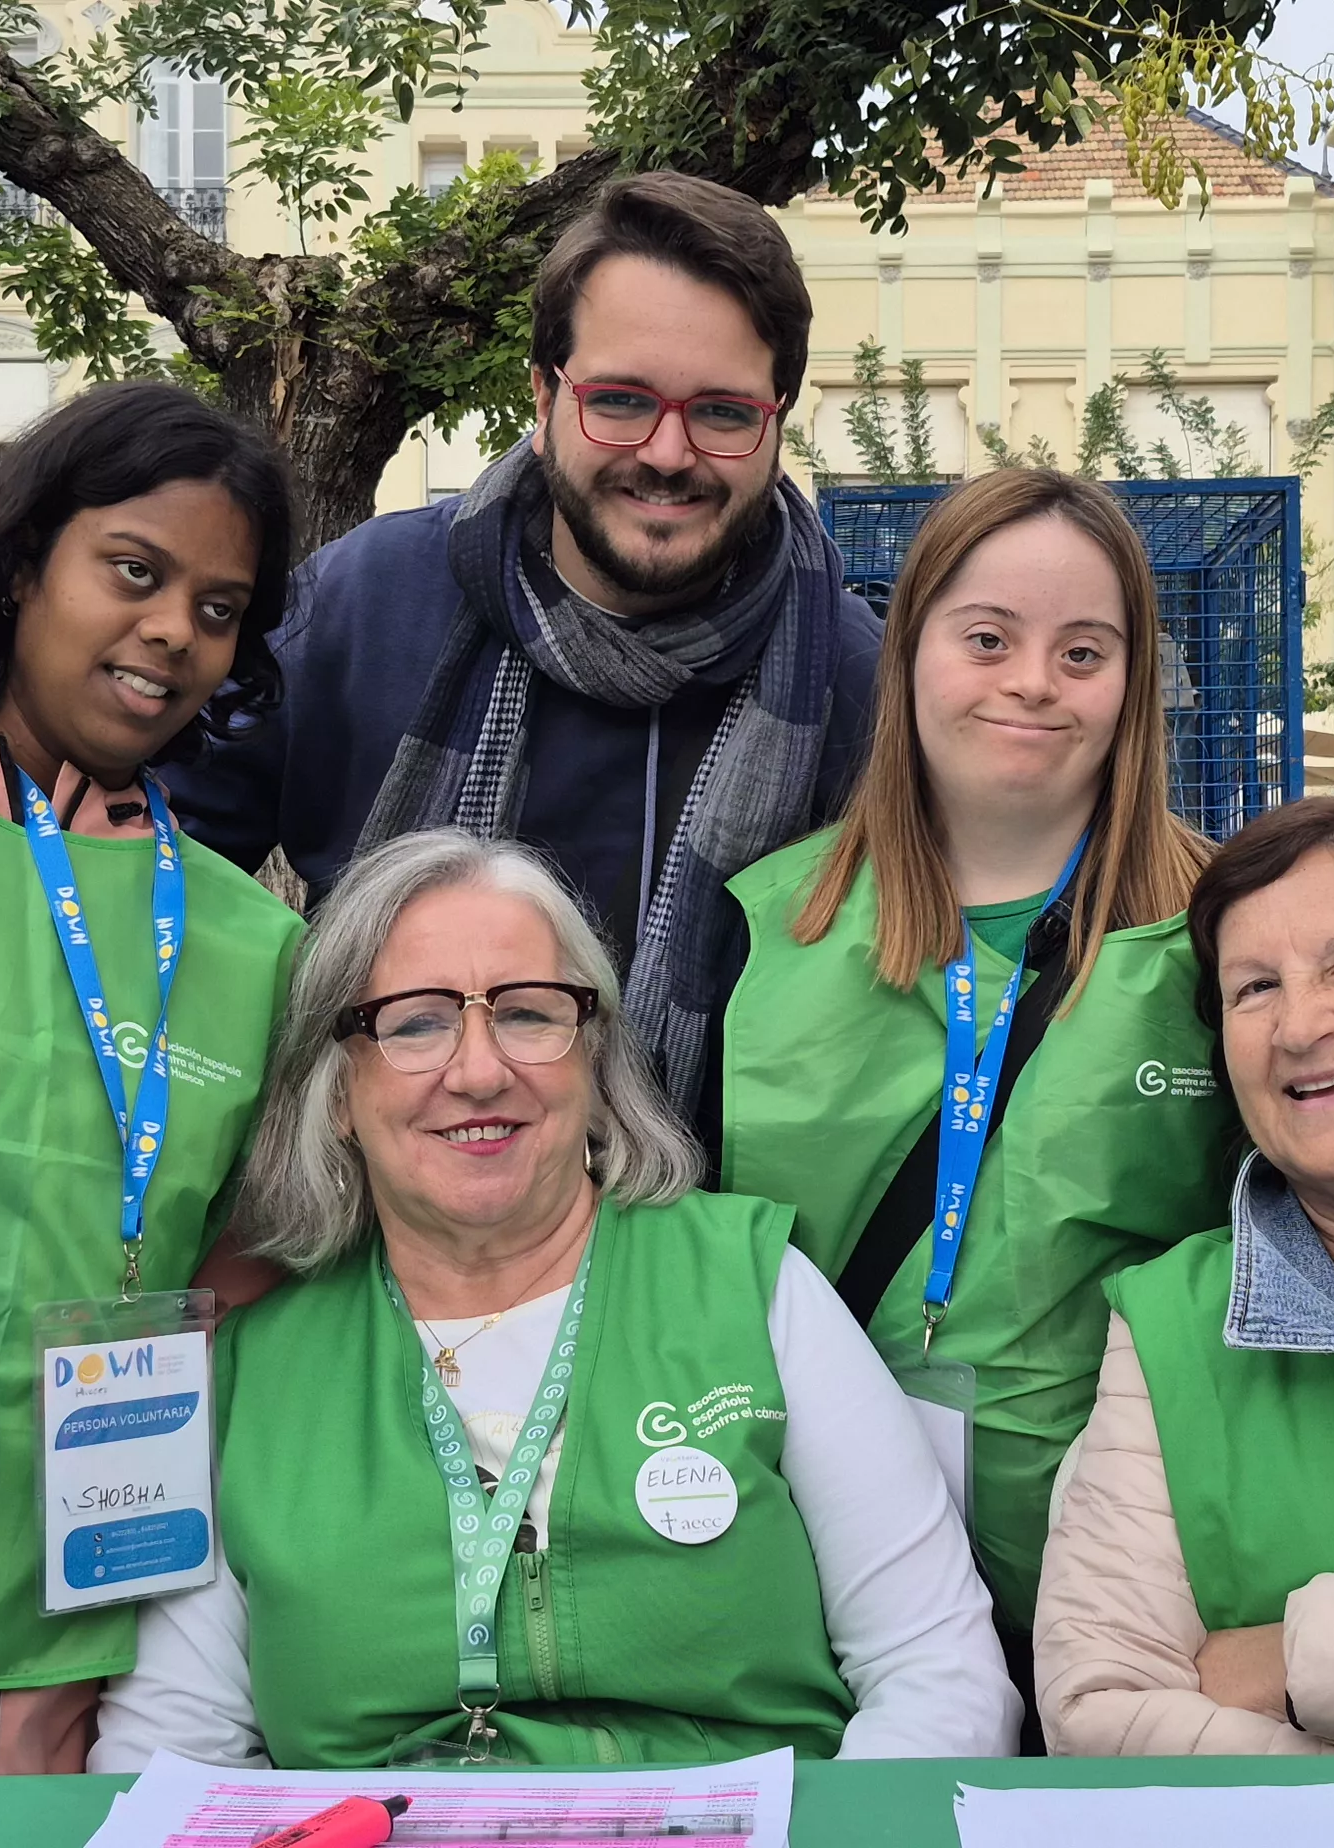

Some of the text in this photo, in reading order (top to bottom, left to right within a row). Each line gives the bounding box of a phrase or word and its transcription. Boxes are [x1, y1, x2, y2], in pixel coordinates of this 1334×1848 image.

[27, 788, 58, 837] DOWN
[156, 819, 175, 871] DOWN
[56, 886, 88, 944] DOWN
[155, 917, 175, 973] DOWN
[956, 965, 972, 1022] DOWN
[88, 998, 116, 1057] DOWN
[170, 1066, 204, 1086] Huesca
[202, 1056, 242, 1078] española
[1171, 1077, 1198, 1087] contra
[1199, 1078, 1207, 1087] el
[951, 1073, 971, 1131] DOWN
[965, 1076, 991, 1133] DOWN
[1170, 1087, 1183, 1095] en
[131, 1120, 161, 1178] DOWN
[941, 1183, 966, 1241] DOWN
[55, 1344, 153, 1387] DOWN
[64, 1405, 192, 1434] PERSONA VOLUNTARIA
[687, 1383, 754, 1414] asociación
[692, 1395, 751, 1426] española
[697, 1407, 788, 1439] contra el cáncer
[77, 1482, 166, 1511] SHOBHA
[647, 1465, 722, 1488] ELENA
